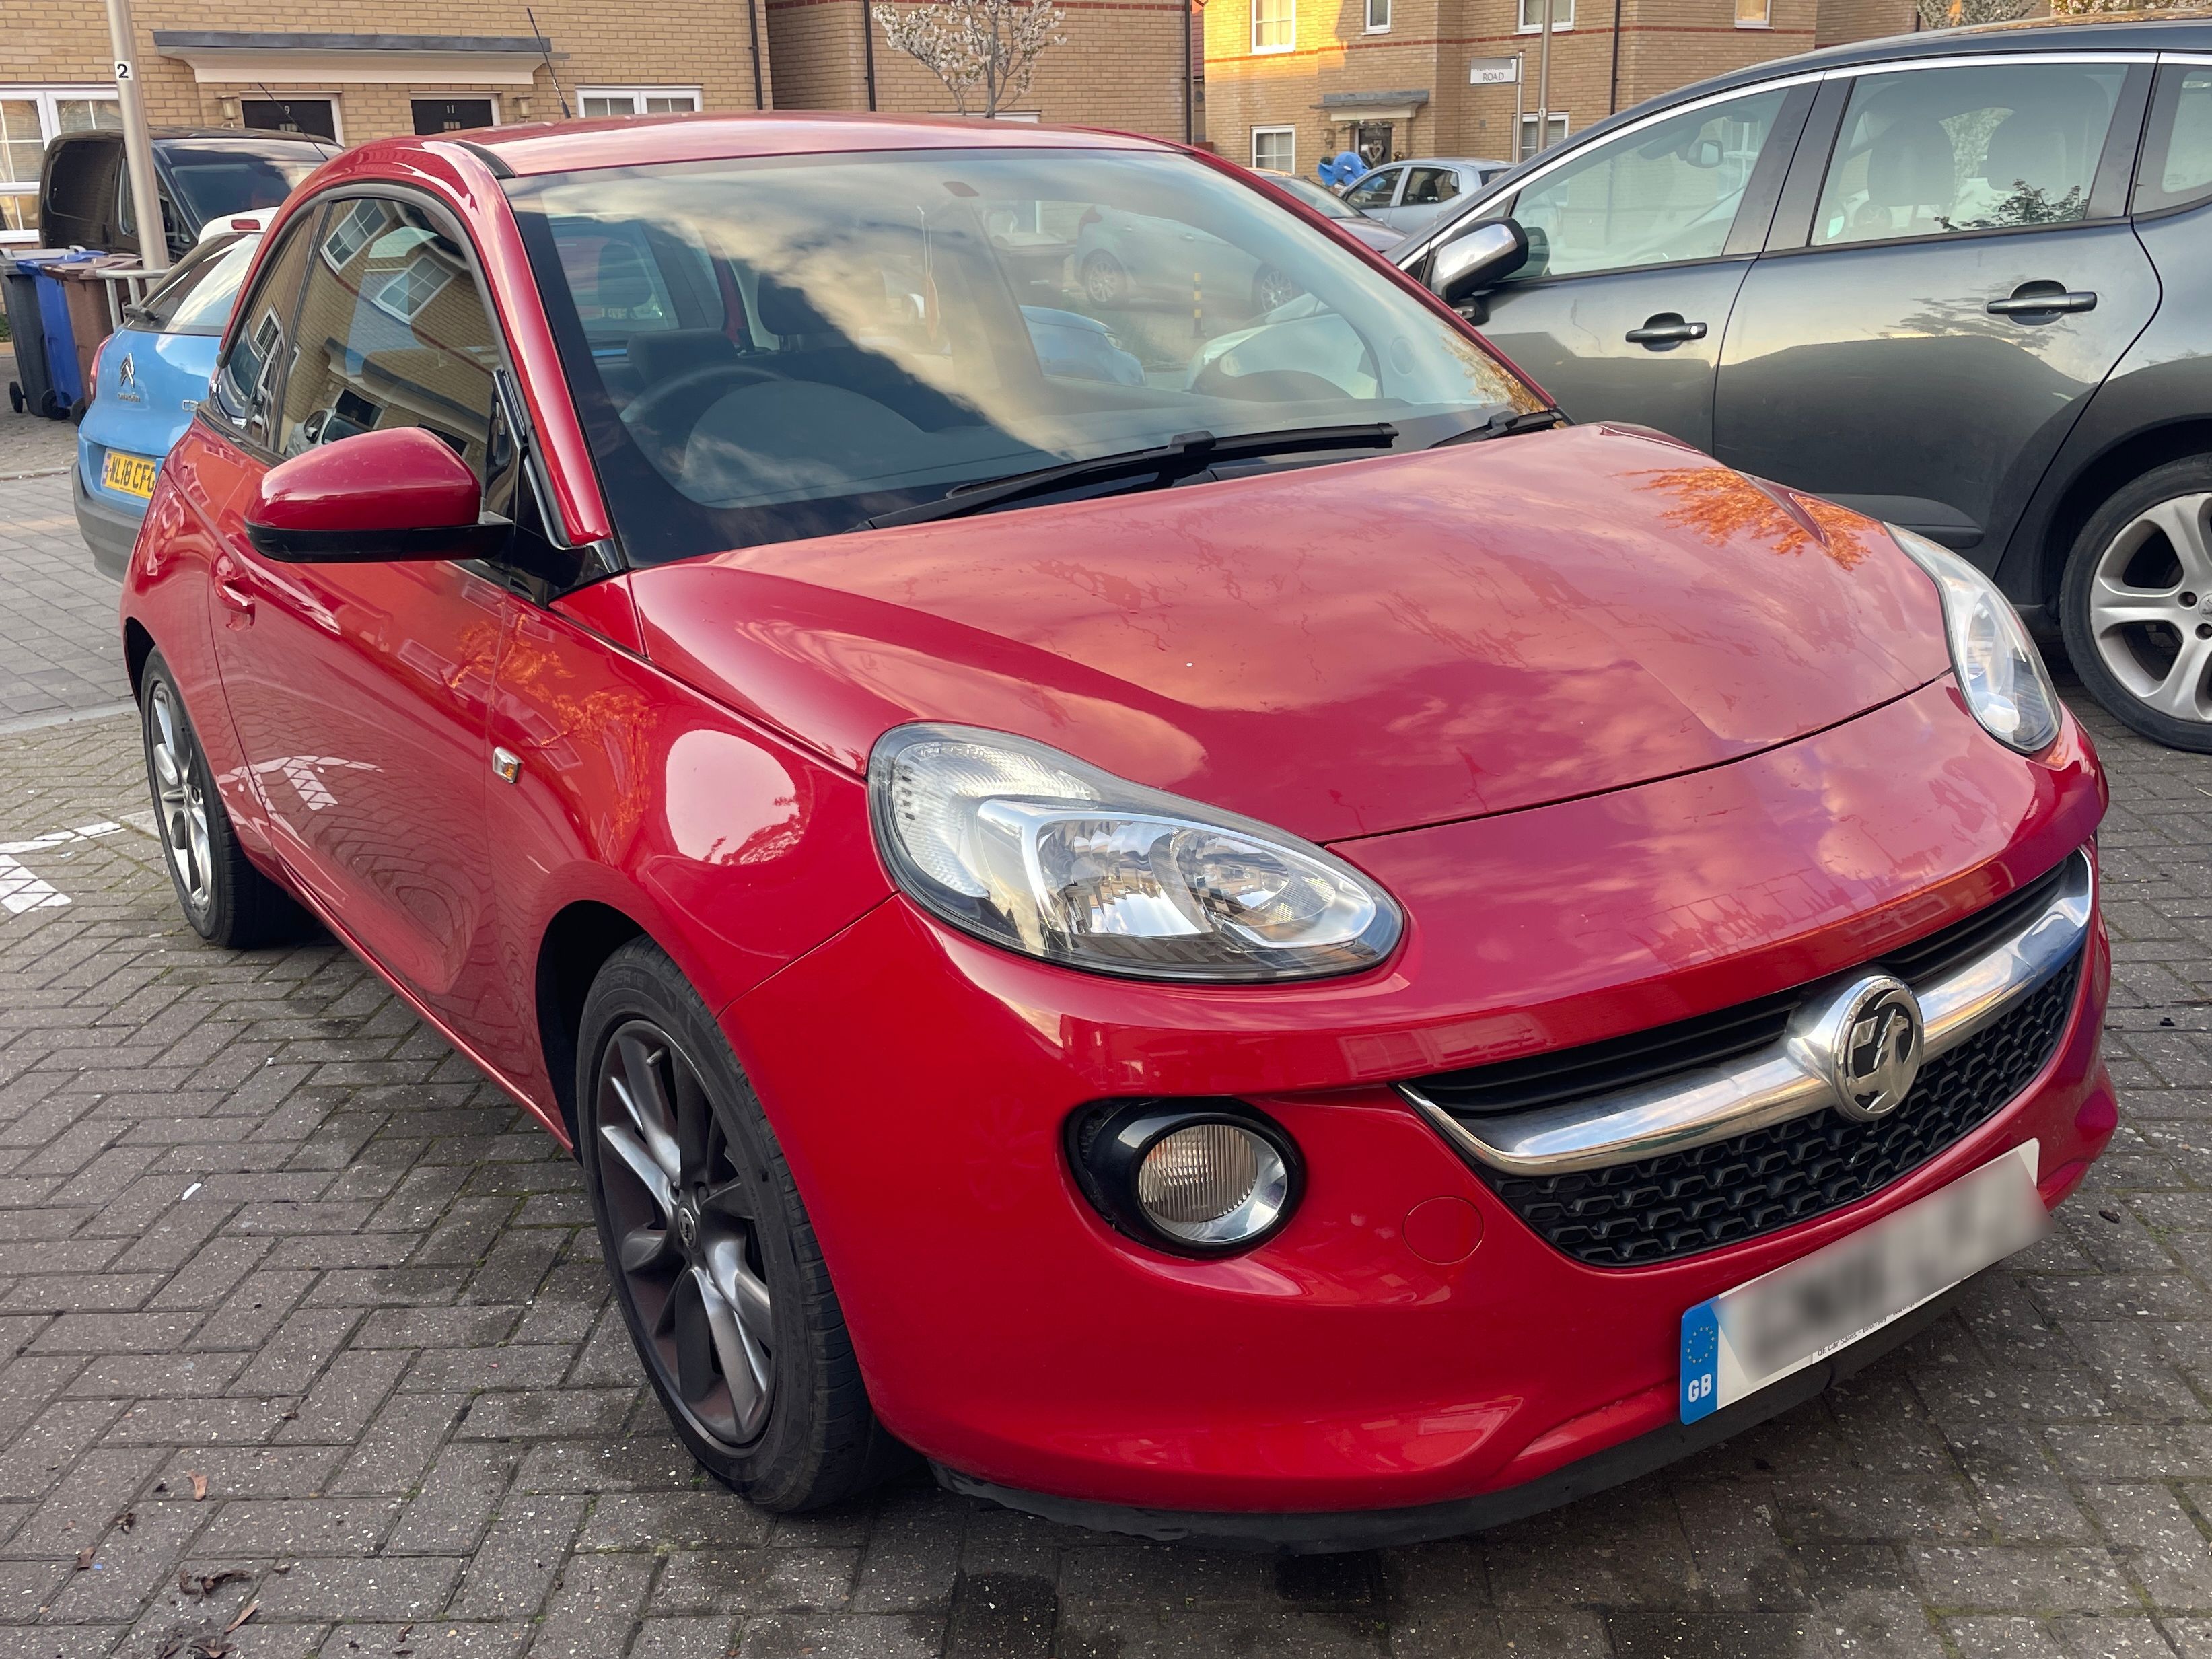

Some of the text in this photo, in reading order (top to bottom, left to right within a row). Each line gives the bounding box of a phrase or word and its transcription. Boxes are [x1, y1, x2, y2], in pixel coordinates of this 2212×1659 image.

[117, 63, 129, 79] 2
[1483, 71, 1504, 81] ROAD
[284, 105, 290, 115] 9
[446, 104, 454, 114] 11
[1828, 1341, 1839, 1351] Car
[1840, 1332, 1857, 1345] Sales
[1688, 1373, 1712, 1403] GB
